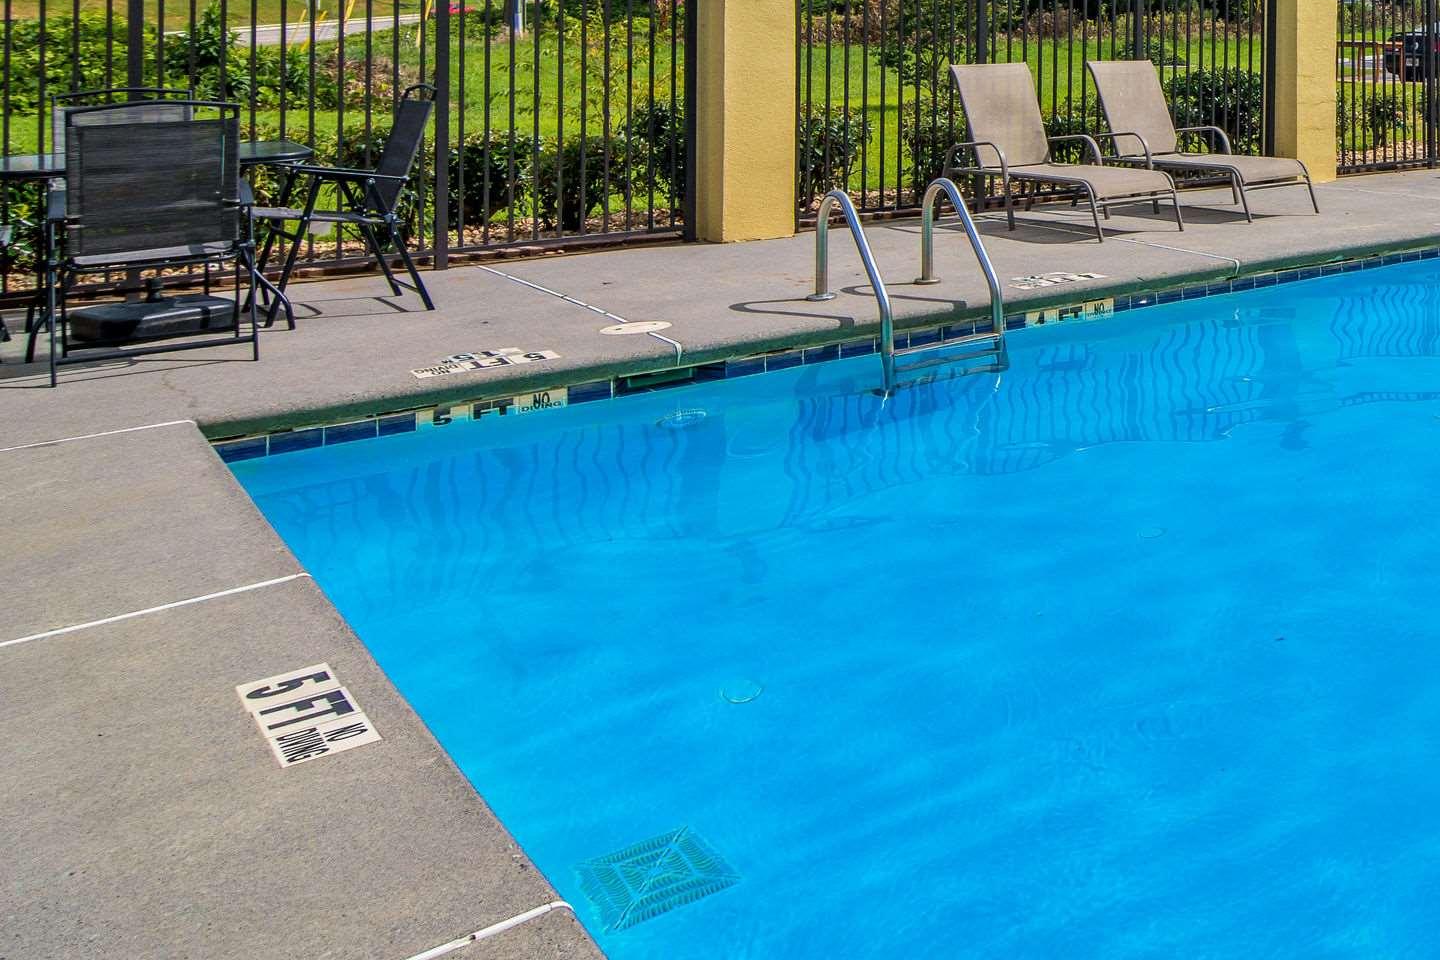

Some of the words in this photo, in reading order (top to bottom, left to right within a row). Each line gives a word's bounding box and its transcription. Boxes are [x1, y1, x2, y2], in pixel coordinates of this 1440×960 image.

[473, 398, 514, 420] FT
[533, 392, 550, 404] NO
[246, 671, 331, 699] 5
[259, 690, 355, 730] FT
[323, 722, 368, 742] NO
[276, 727, 330, 763] DIVING
